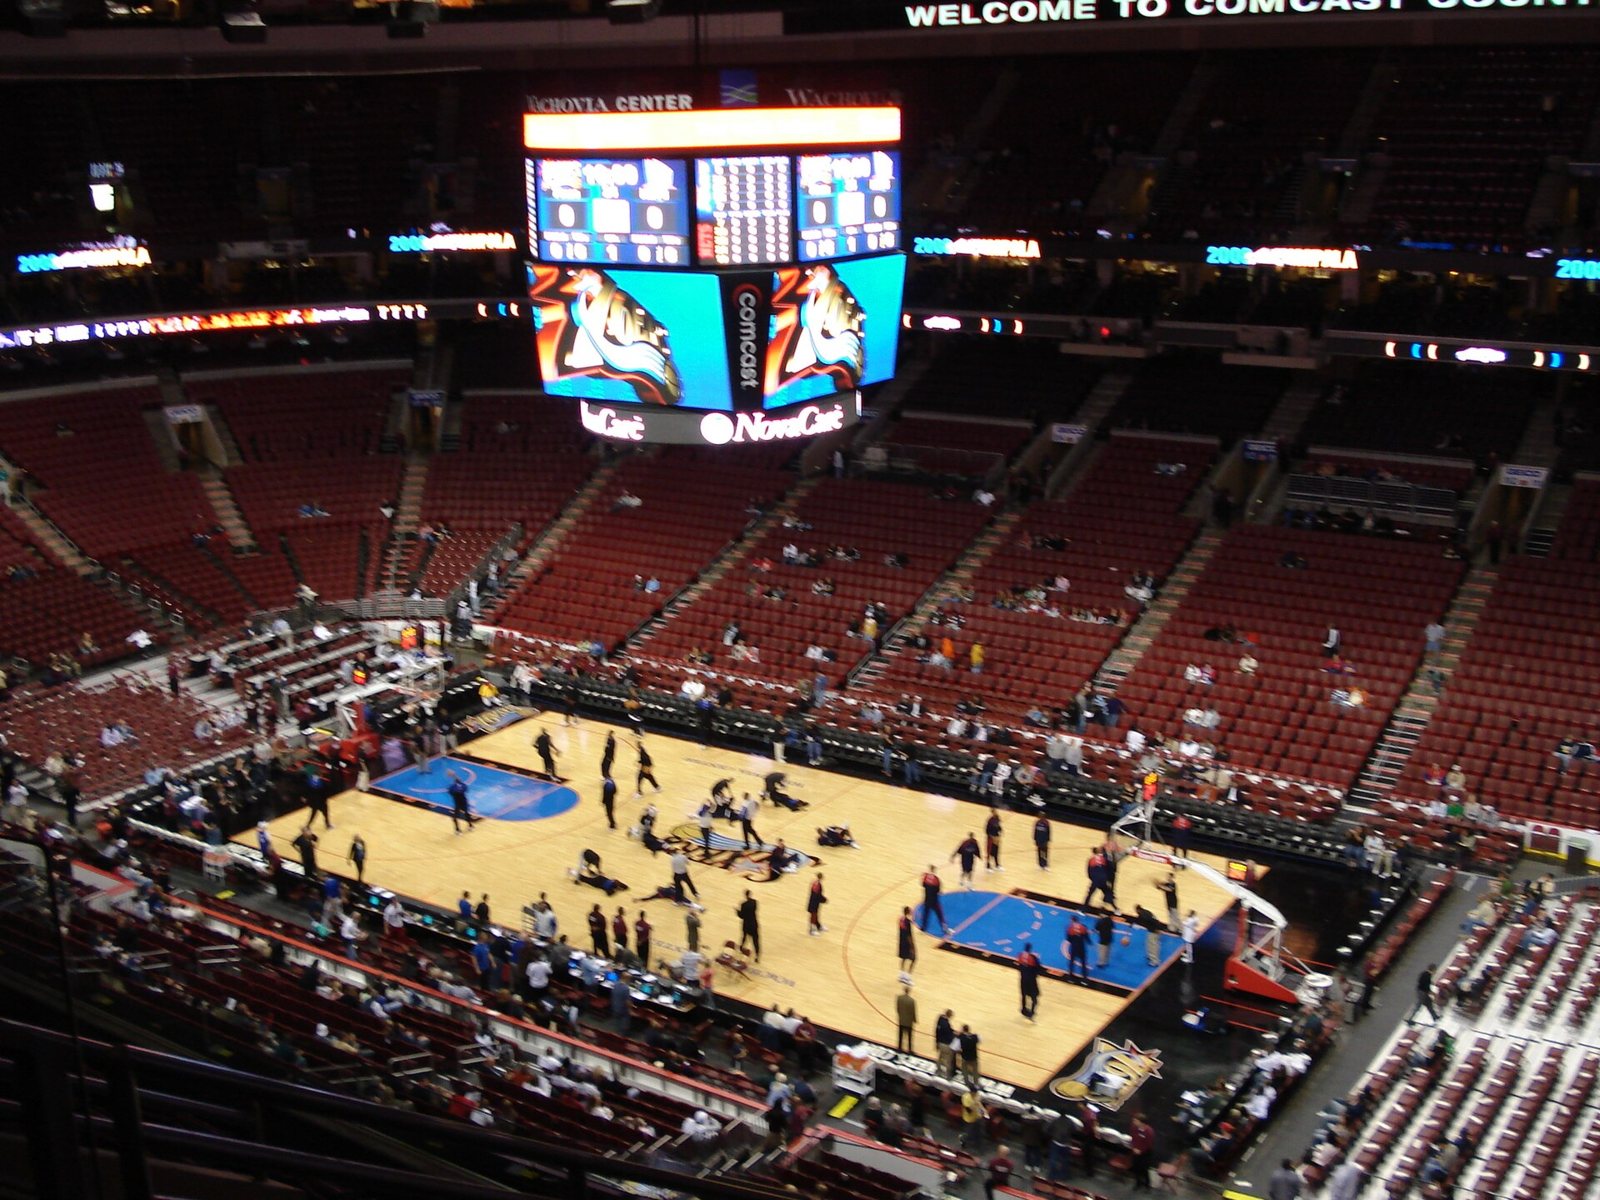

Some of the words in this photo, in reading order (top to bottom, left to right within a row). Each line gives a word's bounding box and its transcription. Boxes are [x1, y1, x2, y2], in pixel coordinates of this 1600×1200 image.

[905, 0, 1097, 27] WELCOME
[1116, 0, 1168, 18] TO
[615, 94, 694, 112] CENTER
[1555, 259, 1600, 280] 200
[738, 292, 760, 390] comcast
